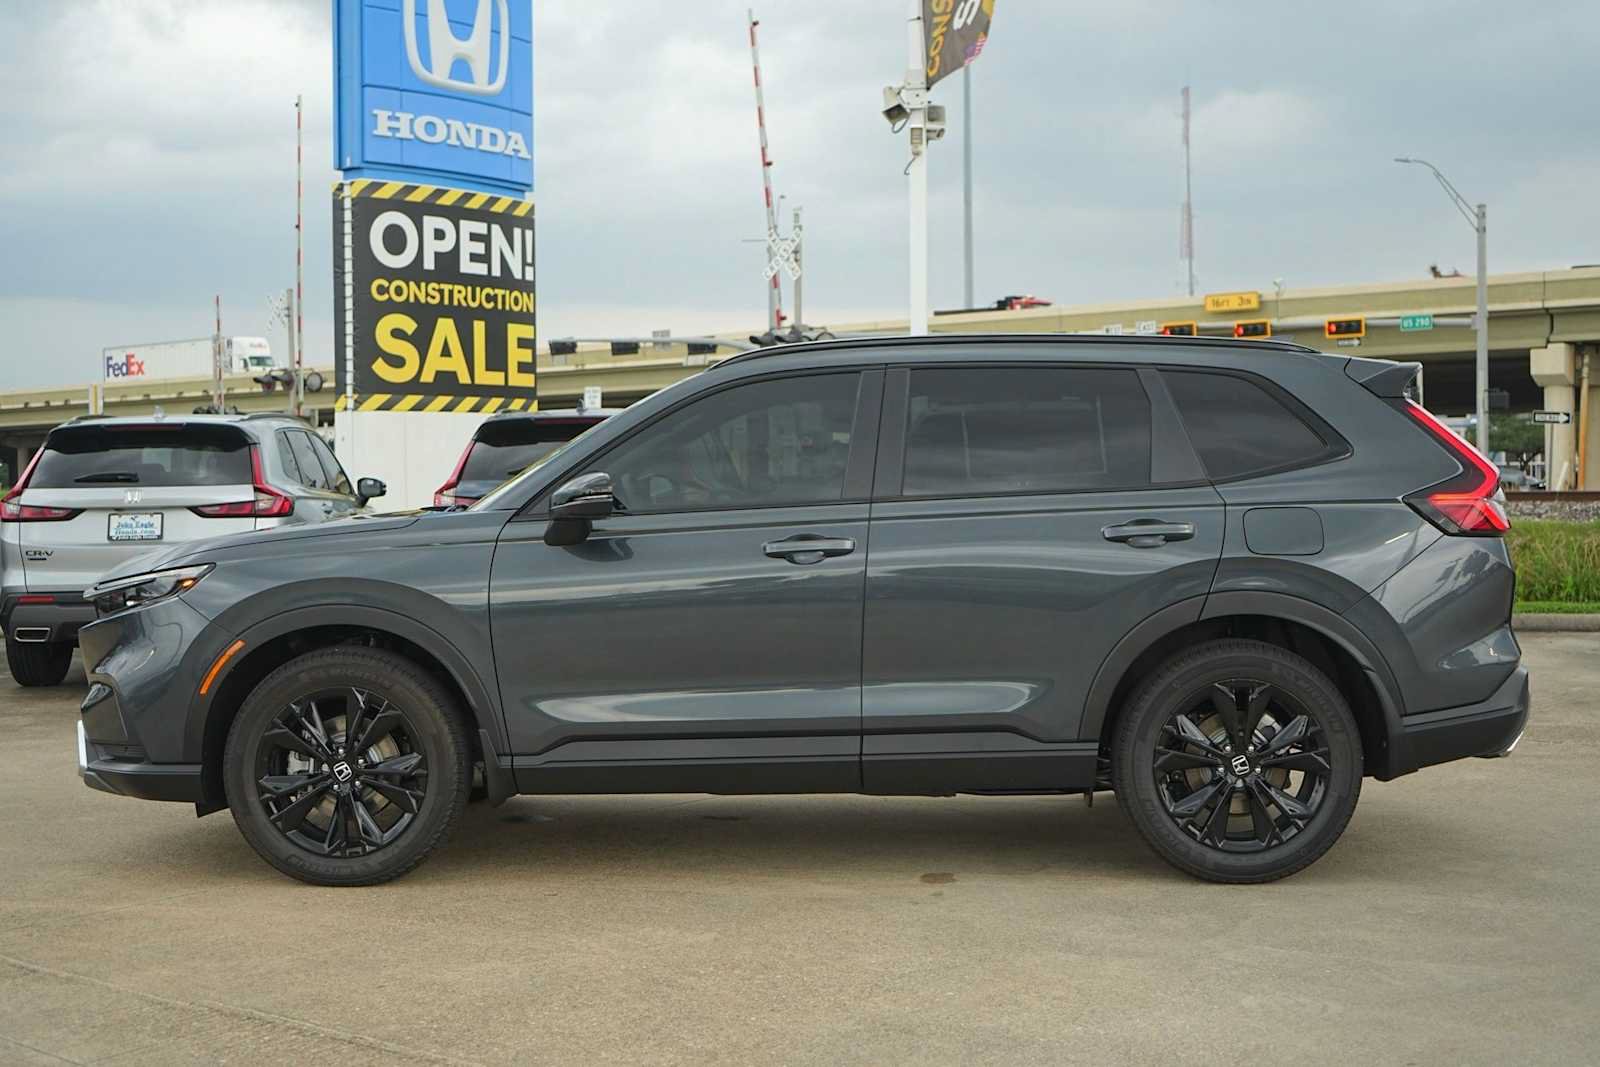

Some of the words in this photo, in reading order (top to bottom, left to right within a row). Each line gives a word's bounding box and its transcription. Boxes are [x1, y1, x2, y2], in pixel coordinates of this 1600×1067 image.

[372, 109, 531, 160] HONDA
[369, 210, 534, 282] OPEN!
[370, 278, 534, 313] CONSTRUCTION
[106, 353, 145, 377] FedEx
[371, 312, 535, 388] SALE
